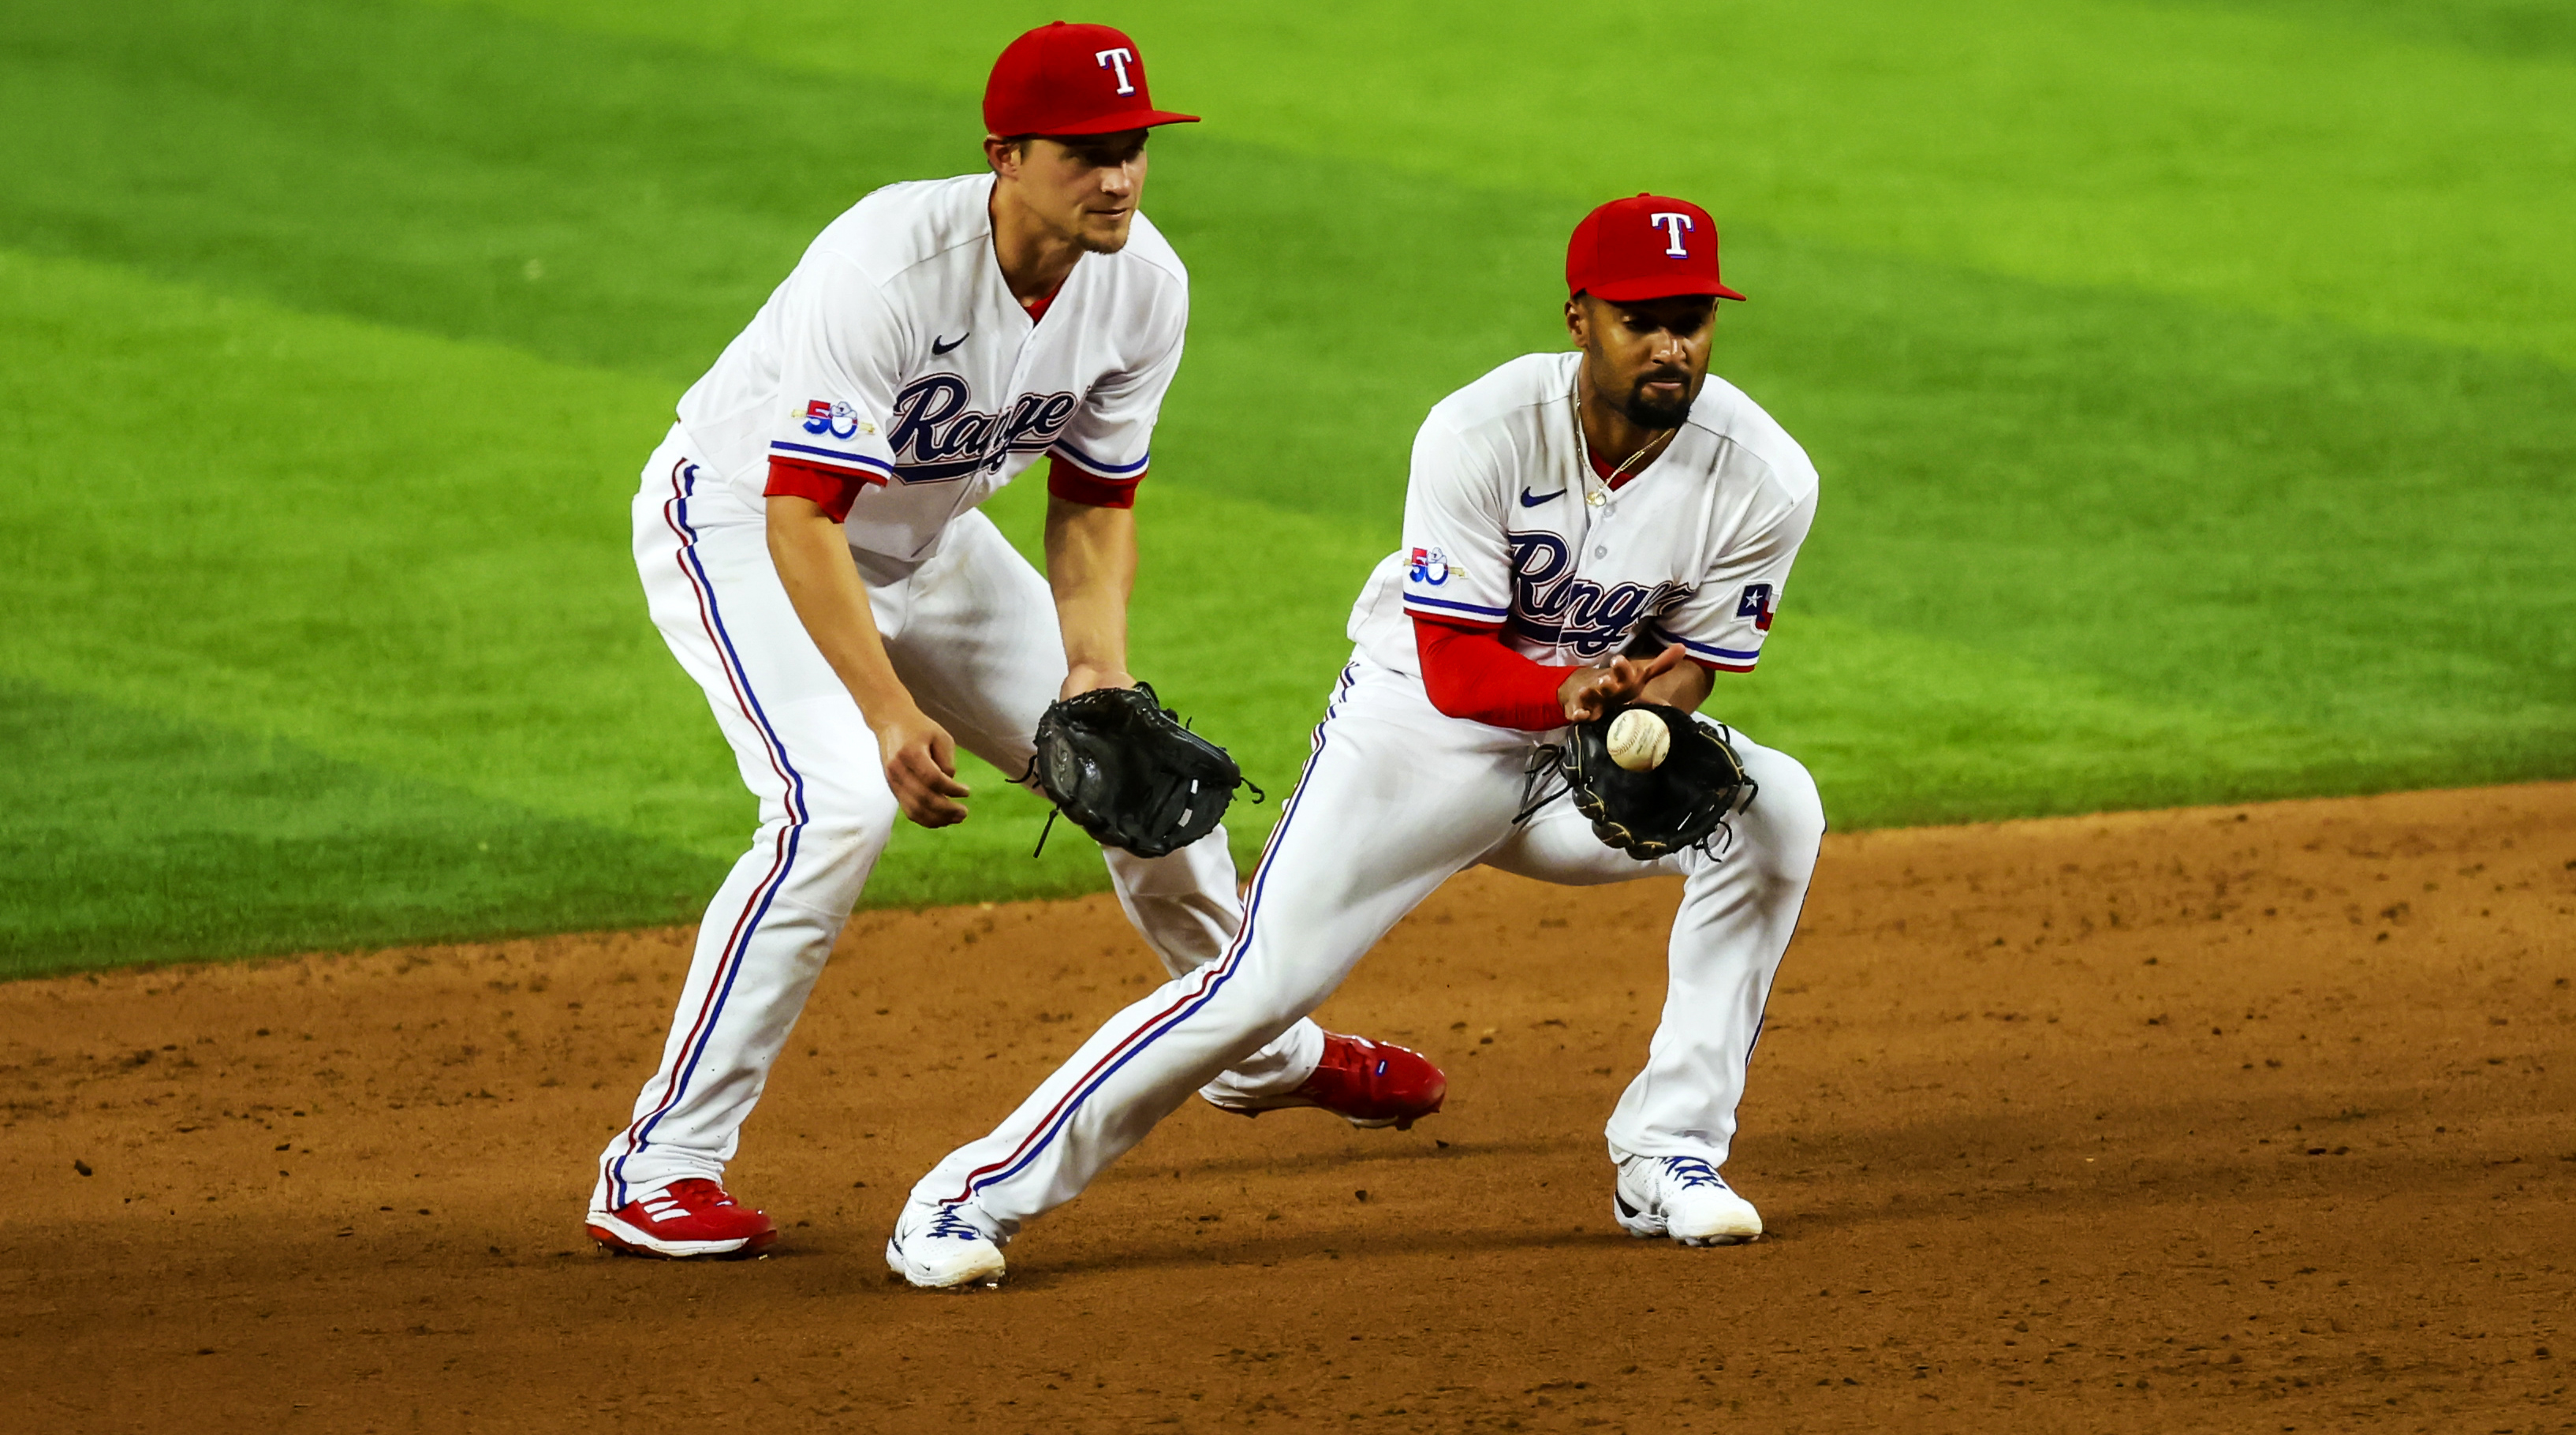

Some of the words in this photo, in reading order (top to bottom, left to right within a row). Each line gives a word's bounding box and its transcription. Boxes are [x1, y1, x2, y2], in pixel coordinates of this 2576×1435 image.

[1096, 47, 1136, 97] T
[1650, 212, 1694, 259] T
[802, 399, 858, 440] 50
[1409, 547, 1449, 586] 50
